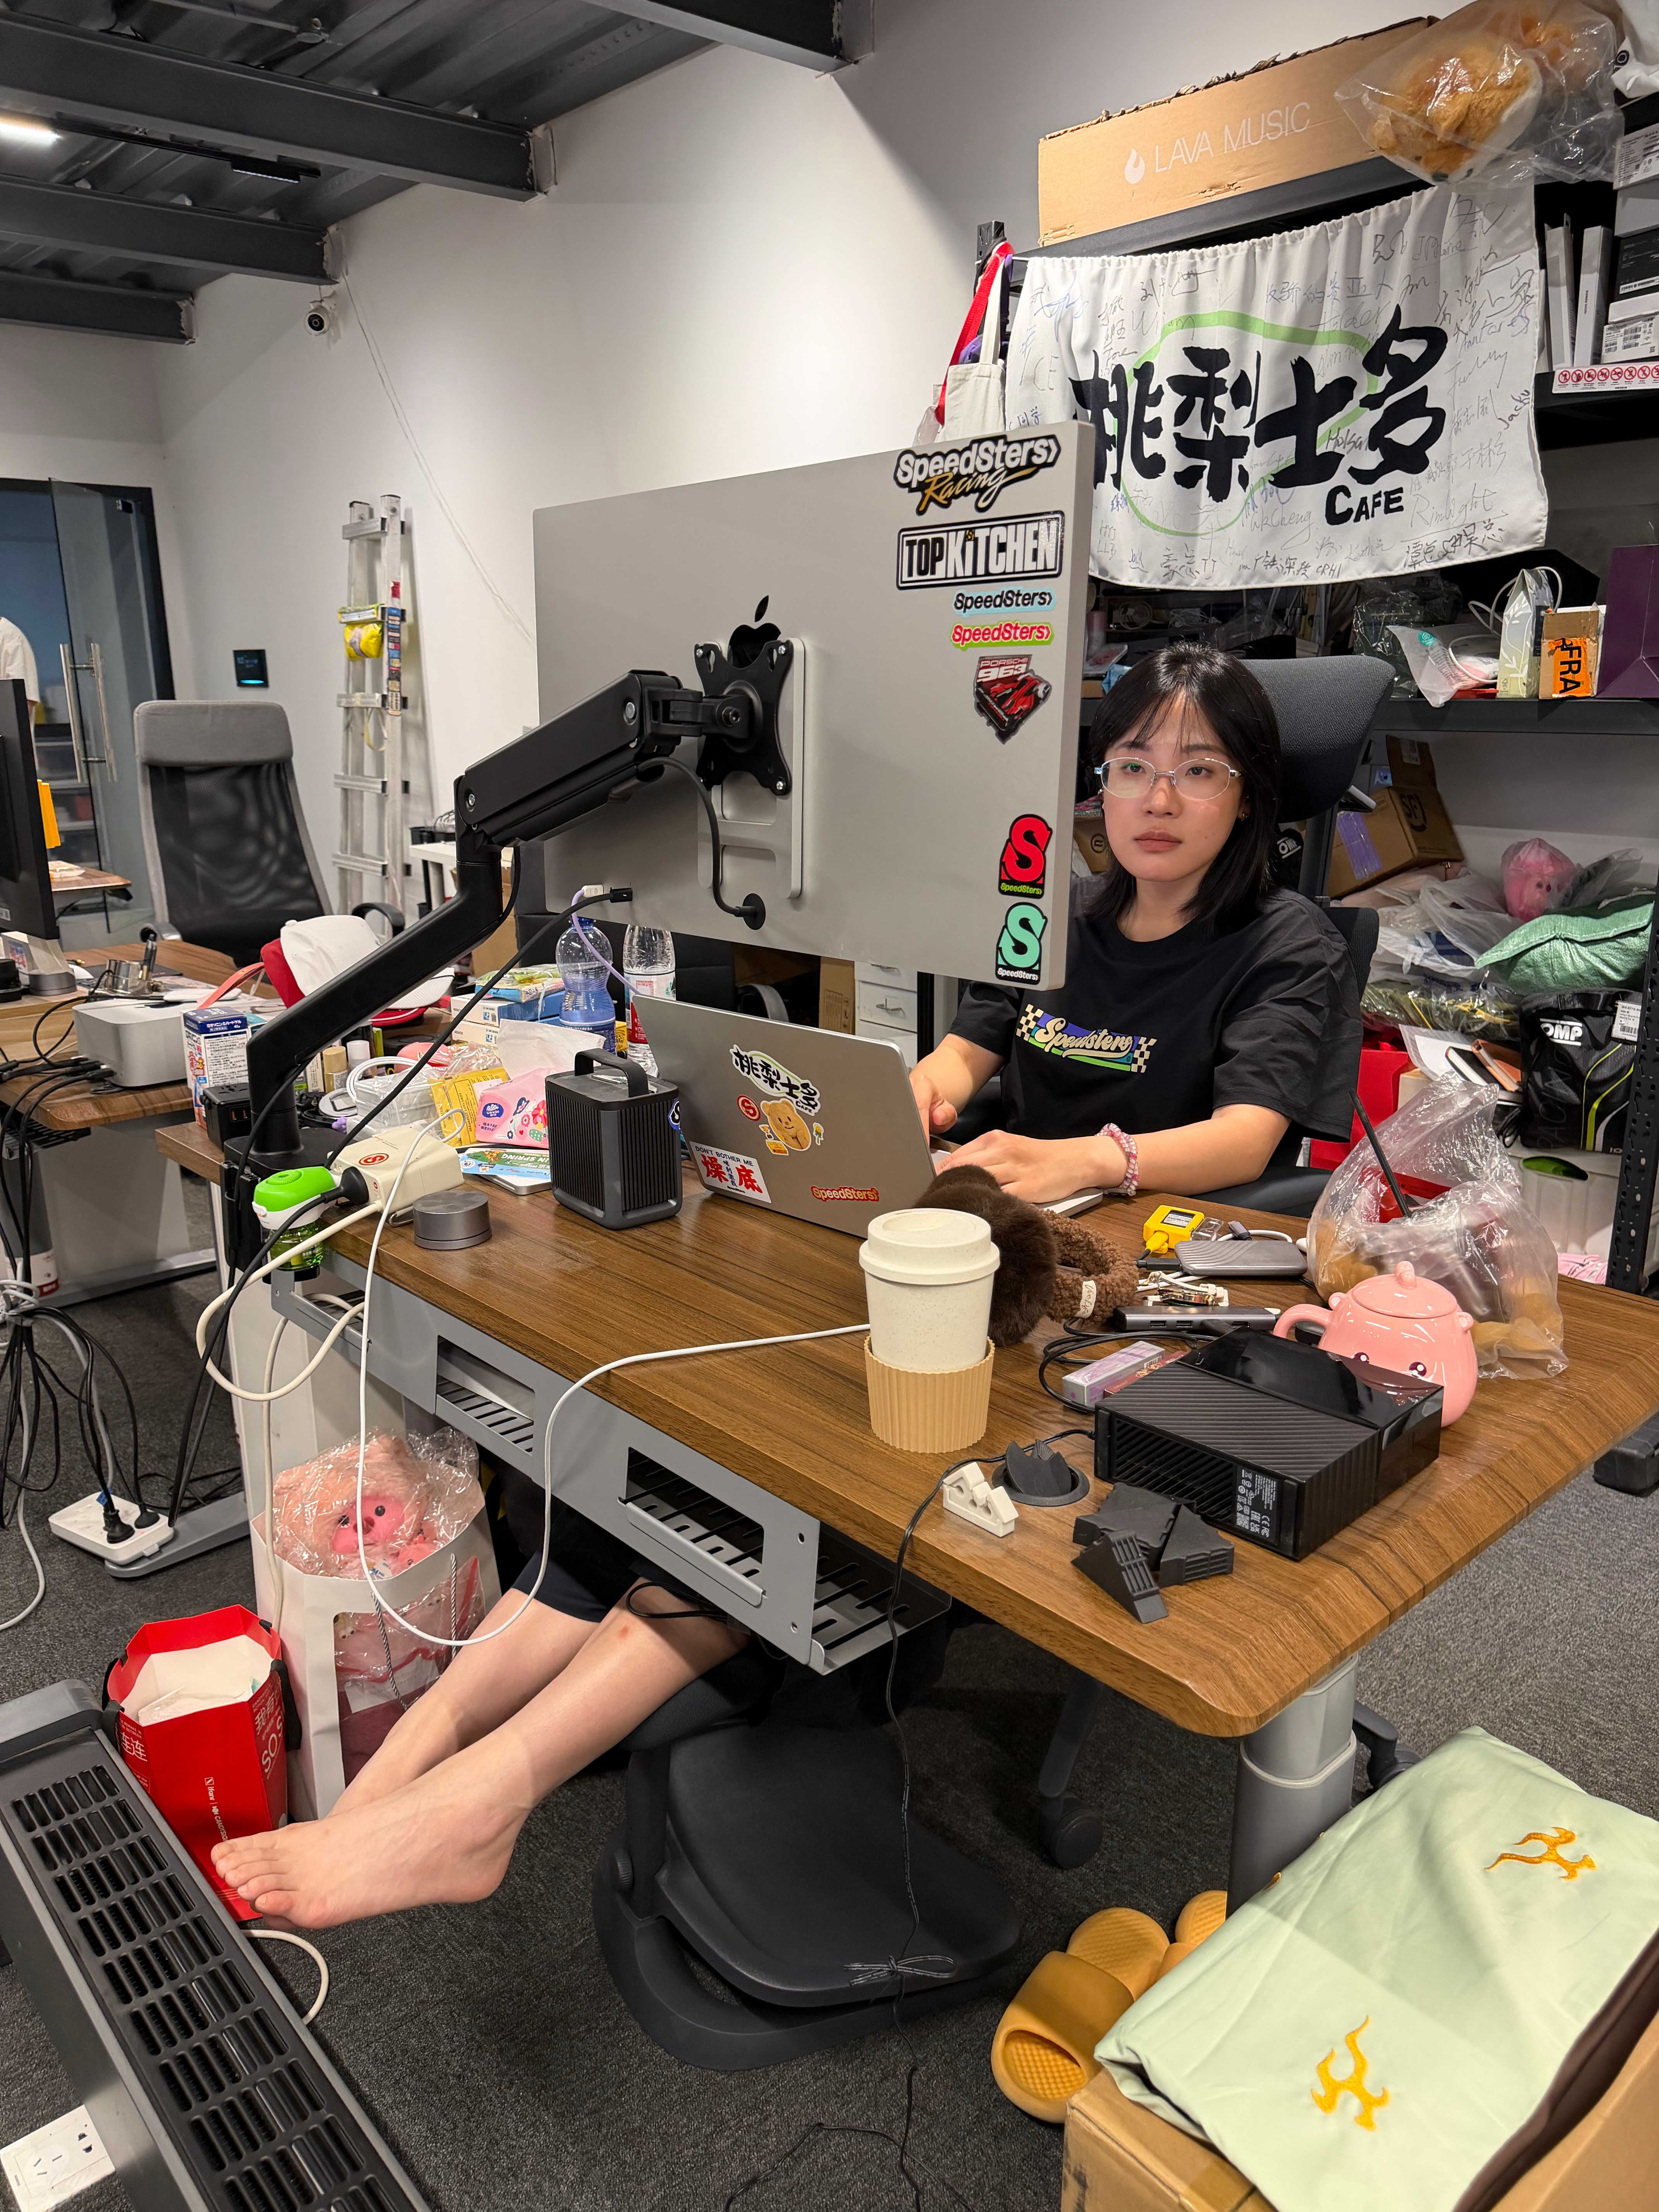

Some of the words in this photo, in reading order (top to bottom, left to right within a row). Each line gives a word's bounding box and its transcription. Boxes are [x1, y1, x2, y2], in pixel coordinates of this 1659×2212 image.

[1155, 131, 1214, 173] LAVA
[1224, 102, 1310, 153] MUSIC
[1068, 304, 1446, 503] 桃梨士多
[919, 466, 1036, 512] Racing
[977, 664, 1027, 682] 963
[980, 658, 1029, 668] PORSCHE
[732, 1047, 820, 1110] 桃梨士多
[500, 1152, 537, 1162] SPRING
[695, 1146, 714, 1156] DON'T
[716, 1151, 742, 1164] BOTHER
